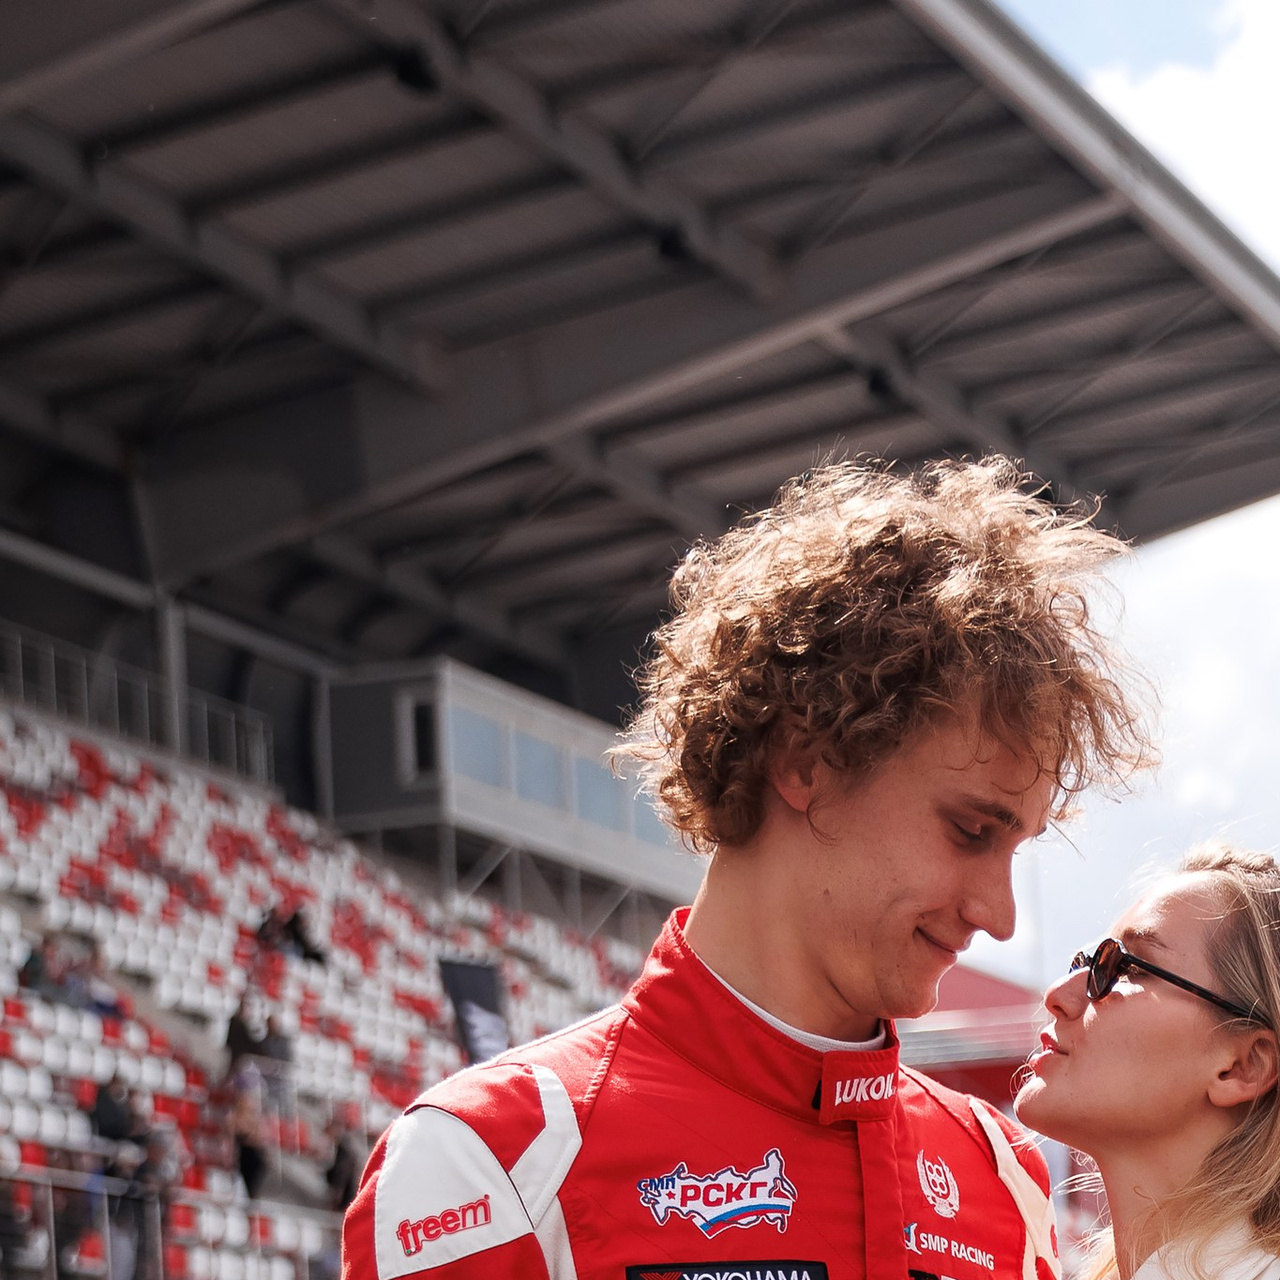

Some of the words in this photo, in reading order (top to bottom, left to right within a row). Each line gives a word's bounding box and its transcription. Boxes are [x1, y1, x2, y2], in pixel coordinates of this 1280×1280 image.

[637, 1178, 676, 1192] СМП
[680, 1181, 768, 1208] РСКГ
[397, 1198, 492, 1254] freem
[919, 1232, 949, 1253] SMP
[951, 1240, 995, 1271] RACING
